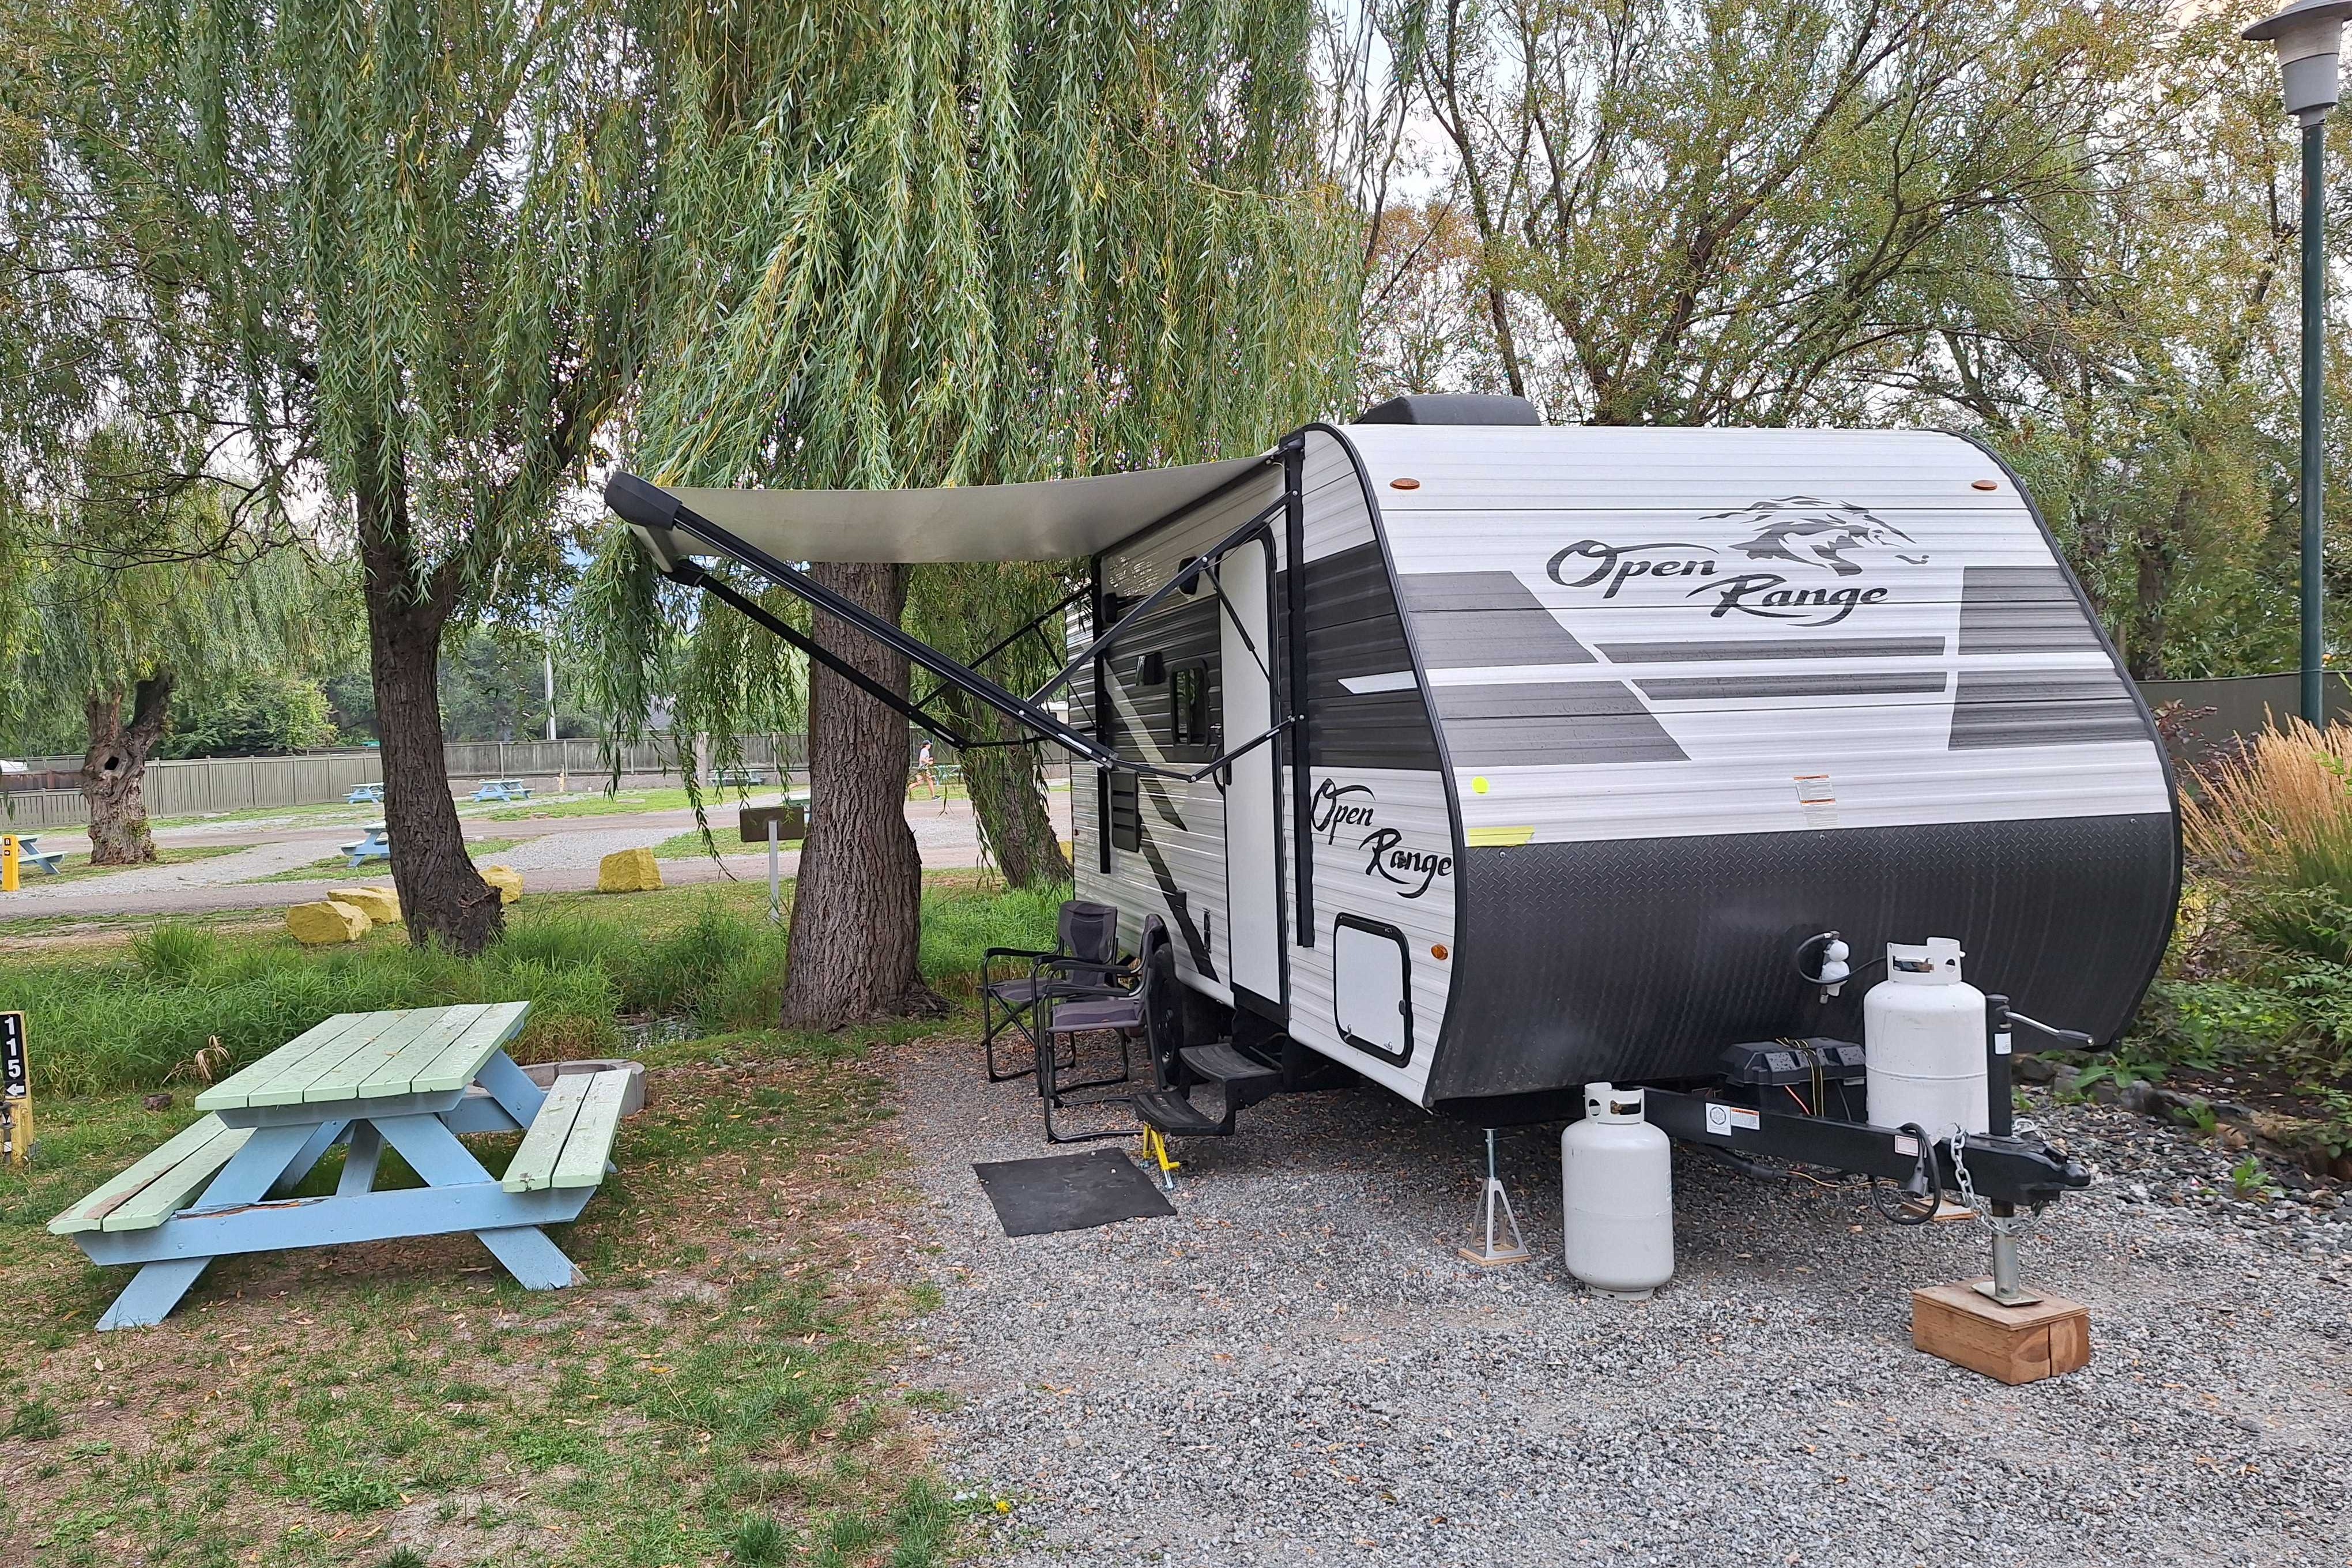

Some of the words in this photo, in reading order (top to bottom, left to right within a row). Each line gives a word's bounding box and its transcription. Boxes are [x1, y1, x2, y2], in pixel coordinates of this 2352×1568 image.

[1547, 540, 1719, 598] Open
[1686, 574, 1888, 627] Range
[1311, 779, 1375, 845] Open
[1359, 828, 1452, 898] Range
[5, 1017, 21, 1077] 115
